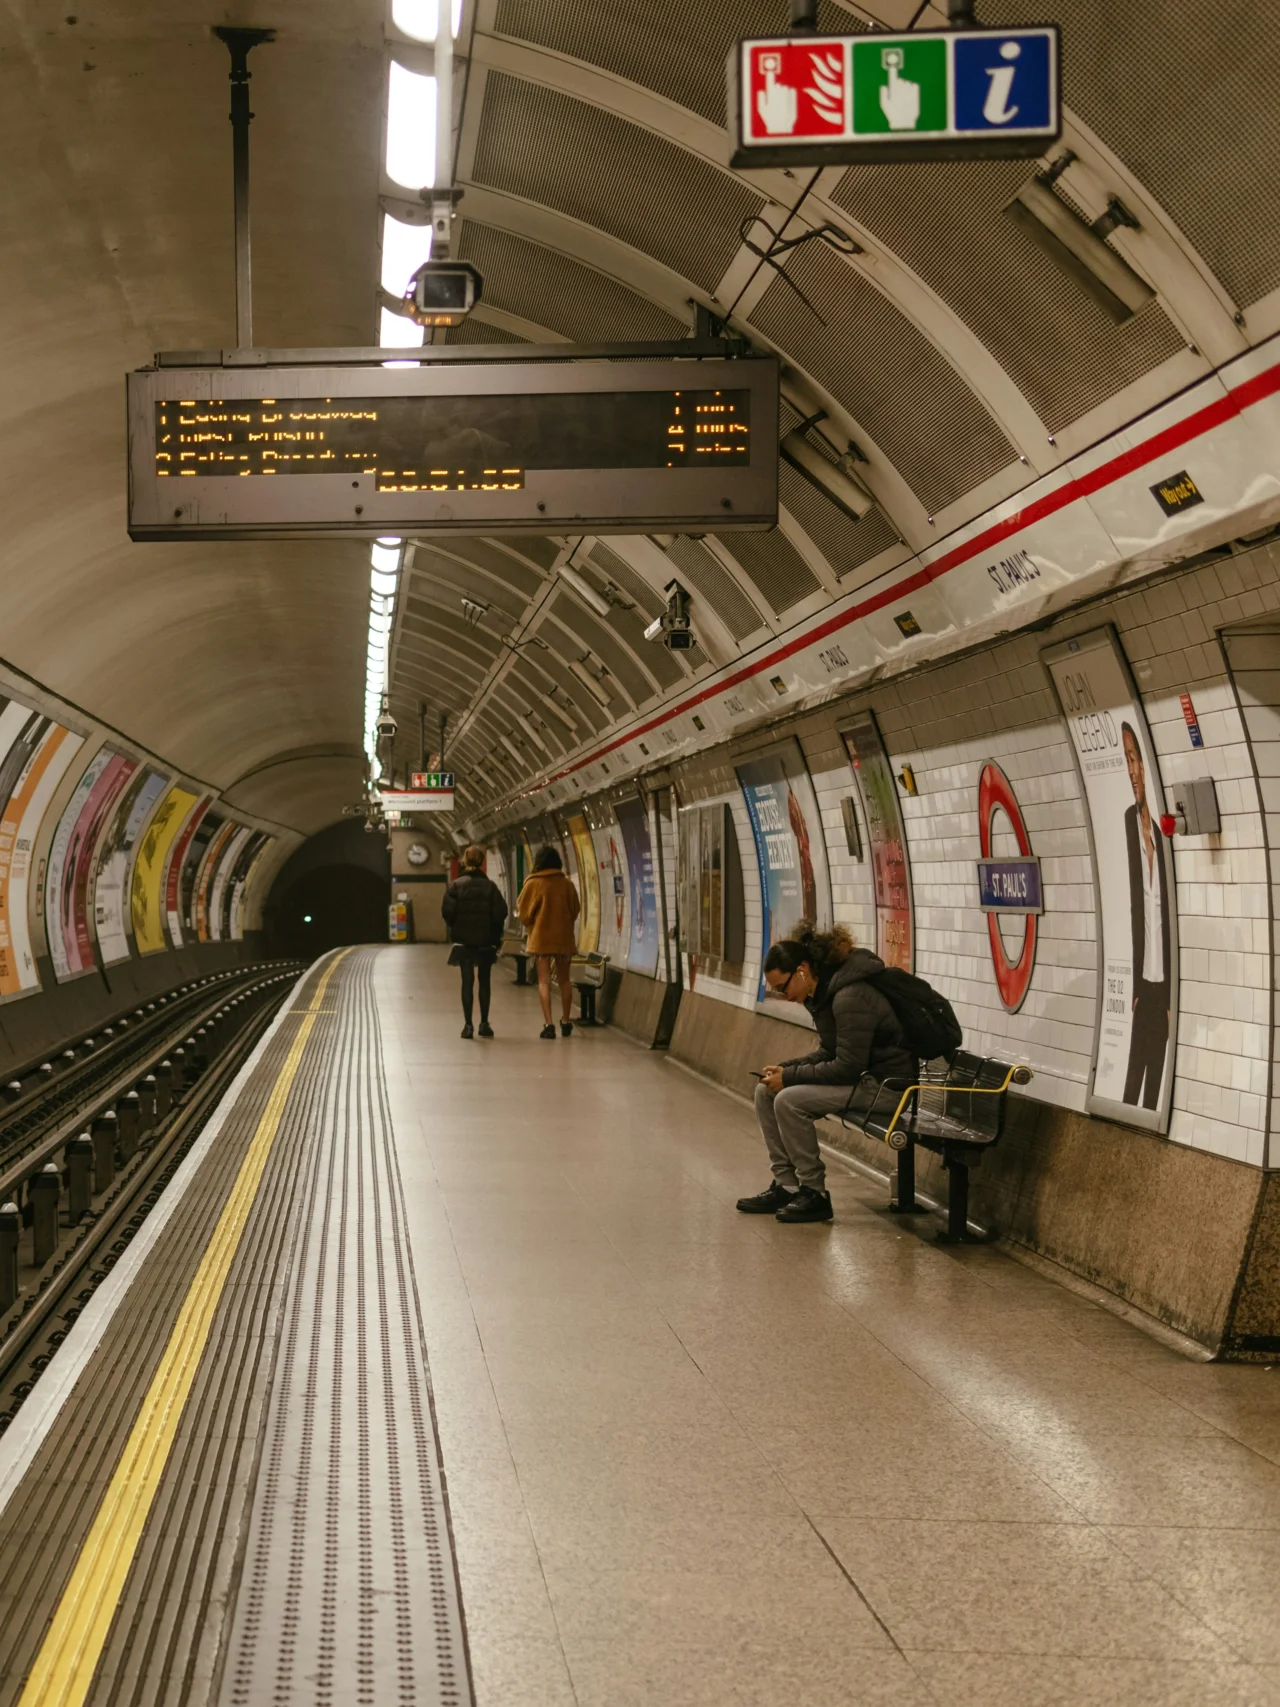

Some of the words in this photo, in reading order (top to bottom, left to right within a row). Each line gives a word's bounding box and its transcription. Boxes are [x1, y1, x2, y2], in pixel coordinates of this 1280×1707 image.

[987, 565, 1011, 594] ST.
[1061, 671, 1096, 712] JOHN
[1072, 710, 1119, 753] LEGEND
[992, 873, 1003, 897] ST.
[1002, 872, 1027, 898] PAUL'S
